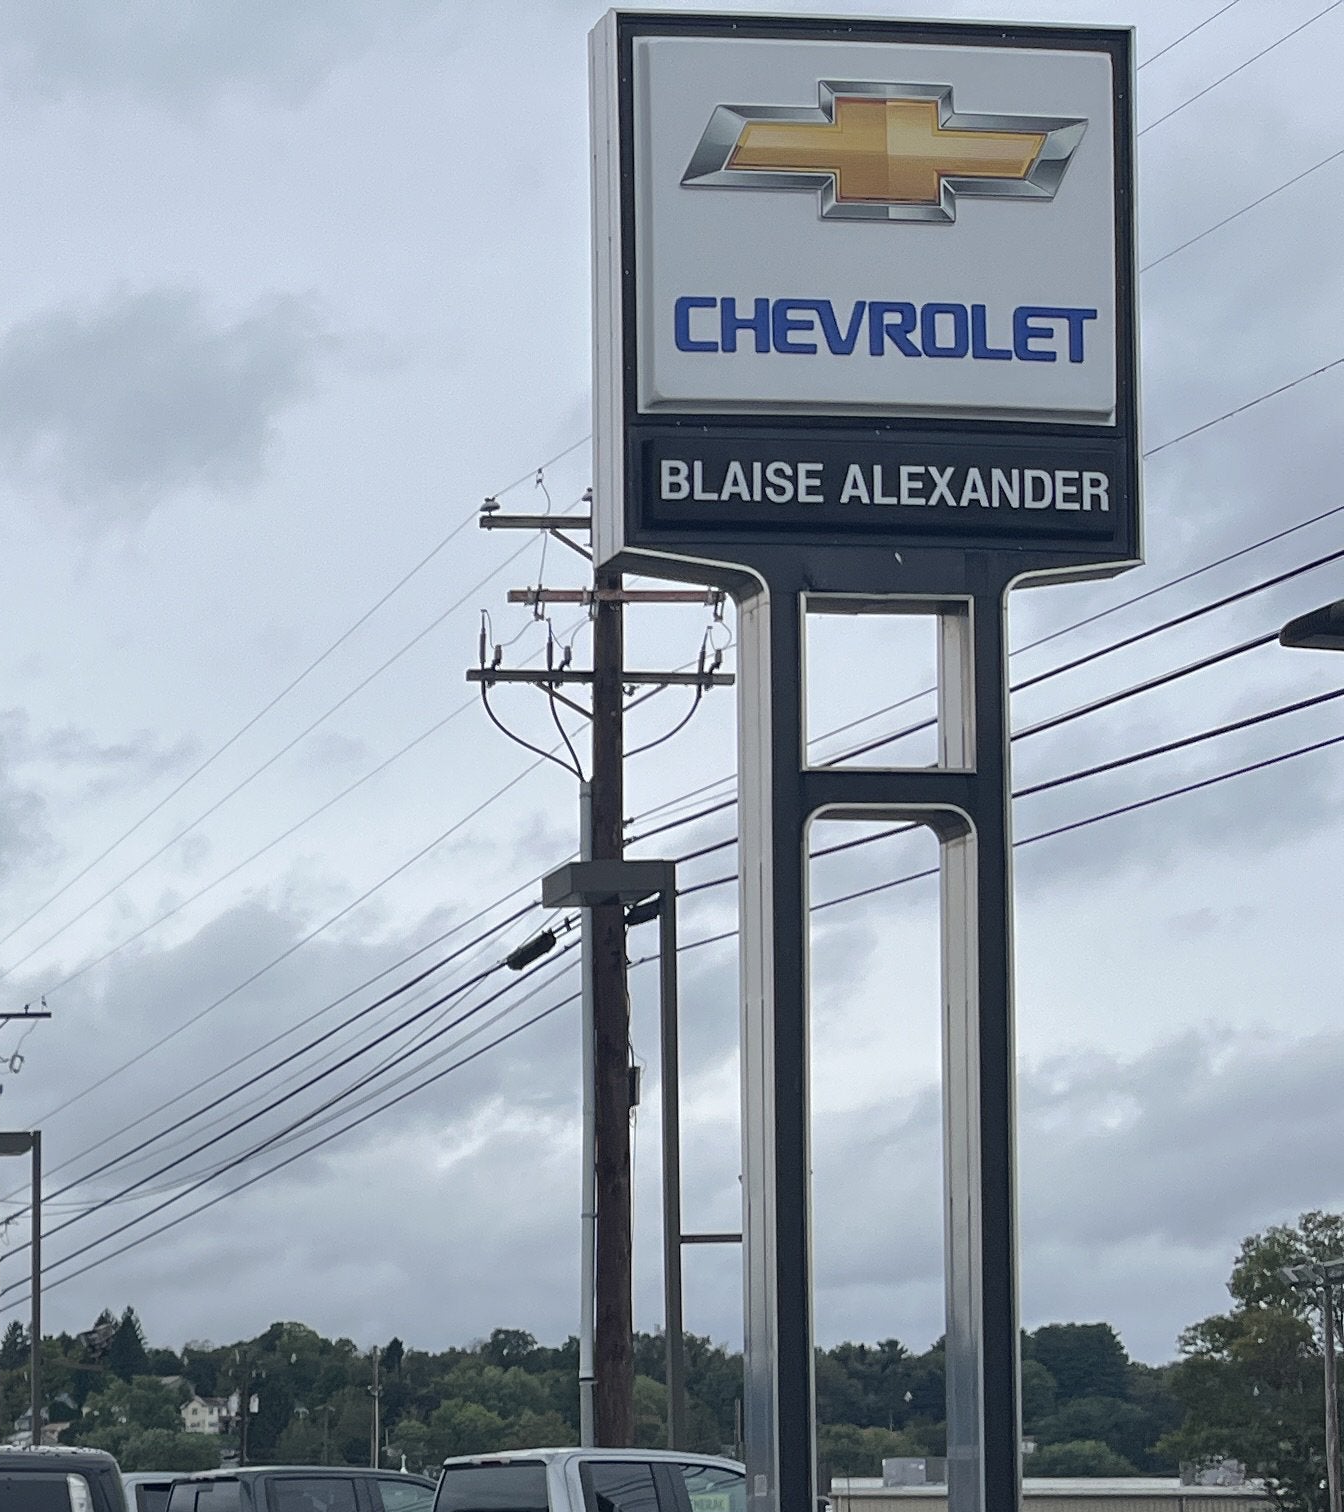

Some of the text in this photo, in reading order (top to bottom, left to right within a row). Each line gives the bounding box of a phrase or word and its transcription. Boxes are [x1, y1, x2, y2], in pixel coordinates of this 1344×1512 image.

[674, 296, 1097, 363] CHEVROLET
[660, 459, 1109, 511] BLAISE ALEXANDER
